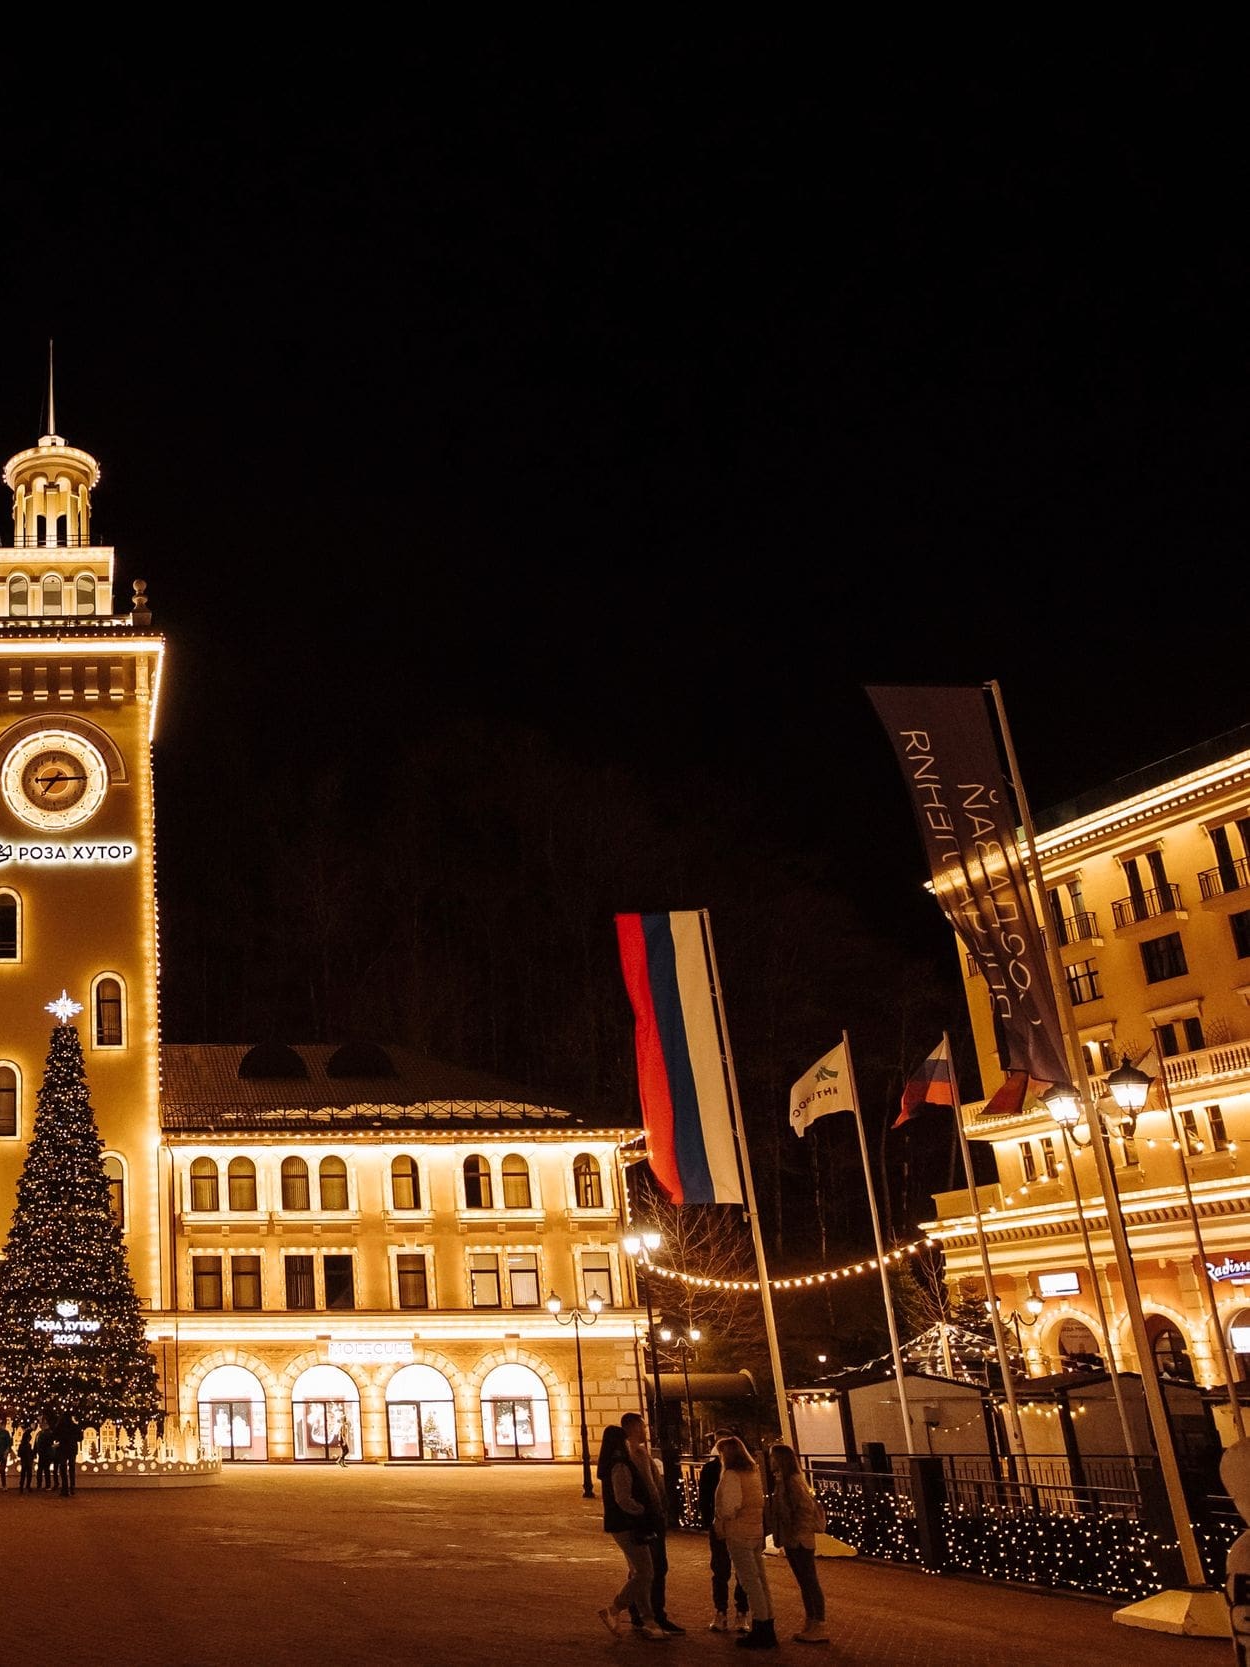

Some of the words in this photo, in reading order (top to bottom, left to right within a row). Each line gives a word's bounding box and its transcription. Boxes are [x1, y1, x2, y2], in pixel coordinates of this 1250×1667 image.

[19, 846, 66, 860] РОЗА
[73, 845, 133, 860] ХУТОР
[34, 1320, 63, 1331] РОЗА
[64, 1320, 101, 1332] ХУТОР
[53, 1334, 81, 1345] 2024
[330, 1343, 412, 1355] MOLECULE
